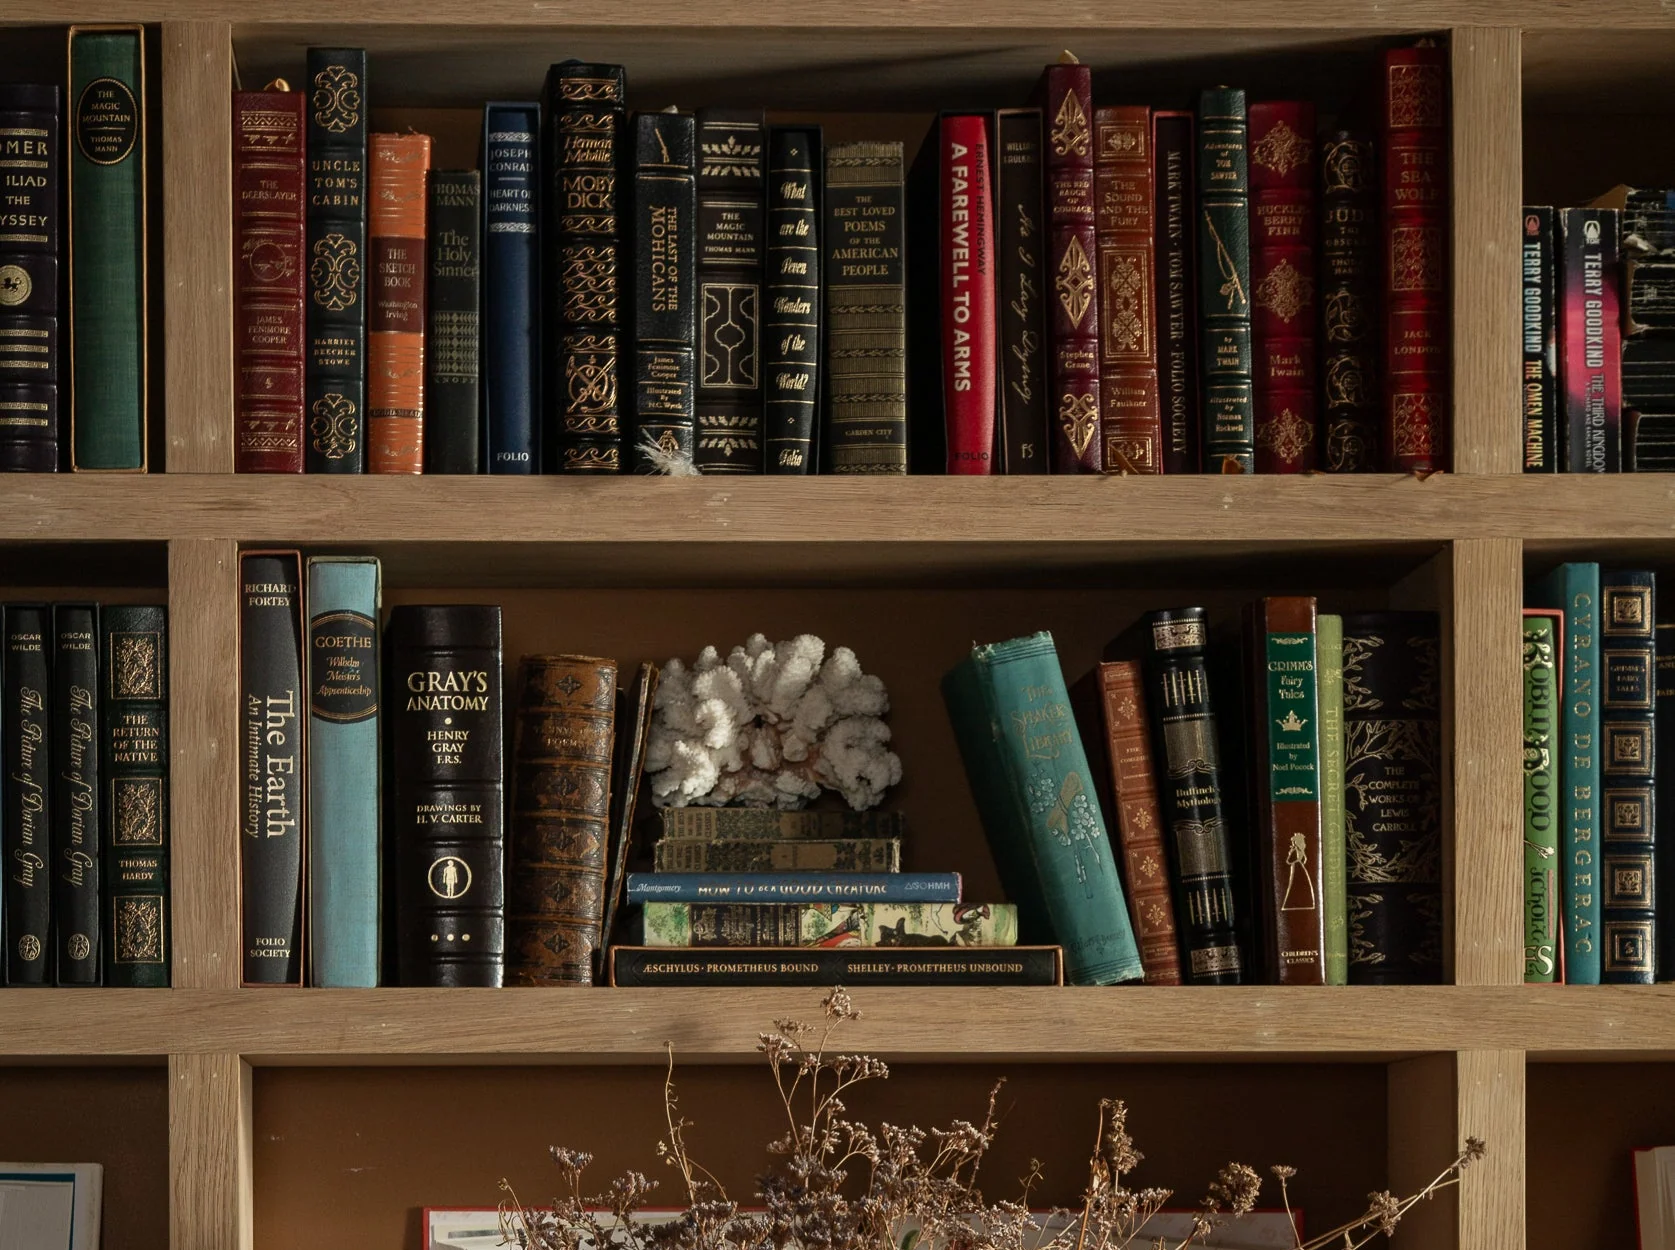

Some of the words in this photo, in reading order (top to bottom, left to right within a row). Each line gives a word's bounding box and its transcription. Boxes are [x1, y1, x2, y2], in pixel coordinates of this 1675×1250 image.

[97, 90, 117, 99] THE
[91, 102, 121, 111] MAGIC
[82, 114, 131, 123] MOUNTAIN
[91, 136, 123, 144] THOMAS
[564, 136, 613, 150] Herman
[491, 149, 532, 161] JOSEPH
[565, 150, 612, 163] Melville
[952, 143, 968, 159] A
[1401, 152, 1434, 166] THE
[312, 160, 361, 172] UNCLE
[490, 162, 533, 173] CONRAD
[6, 175, 47, 188] ILIAD
[315, 177, 358, 189] TOM'S
[563, 175, 616, 191] MOBY
[1401, 170, 1431, 184] SEA
[260, 180, 279, 190] THE
[433, 183, 480, 195] THOMAS
[1112, 180, 1136, 190] THE
[242, 191, 297, 201] DEERSLAYER
[312, 194, 359, 206] CABIN
[1105, 192, 1143, 202] SOUND
[1394, 188, 1439, 201] WOLF
[5, 196, 31, 206] THE
[567, 193, 613, 209] DICK
[490, 203, 534, 213] DARKNESS
[833, 208, 859, 217] BEST
[862, 206, 896, 216] LOVED
[721, 212, 740, 220] THE
[1111, 217, 1138, 226] FURY
[716, 223, 745, 231] MAGIC
[843, 220, 887, 232] POEMS
[952, 165, 971, 289] FAREWELL
[440, 230, 470, 246] The
[706, 233, 755, 242] MOUNTAIN
[975, 191, 987, 277] HEMINGWAY
[387, 248, 407, 260] THE
[437, 248, 472, 265] Holy
[650, 204, 666, 312] MOHICANS
[831, 247, 899, 259] AMERICAN
[380, 262, 416, 275] SKETCH
[1524, 241, 1541, 284] TERRY
[433, 262, 482, 279] Sinner
[841, 264, 889, 276] PEOPLE
[1584, 252, 1602, 295] TERRY
[384, 276, 411, 288] BOOK
[667, 287, 678, 311] THE
[774, 296, 812, 315] Wonders
[954, 291, 971, 323] TO
[1524, 289, 1543, 353] GOODKIND
[249, 325, 292, 335] FENIMORE
[1585, 300, 1604, 368] GOODKIND
[252, 335, 287, 345] COOPER
[314, 338, 355, 347] HARRIET
[313, 349, 357, 357] BEECHER
[1060, 350, 1094, 359] Stephen
[1270, 354, 1301, 364] Mark
[954, 329, 971, 392] ARMS
[1065, 361, 1090, 369] Crane
[1271, 367, 1304, 377] Twain
[1525, 359, 1543, 380] THE
[776, 372, 809, 391] World?
[1591, 374, 1604, 395] THE
[1110, 399, 1147, 408] Faulkner
[1591, 396, 1604, 427] THIRD
[1527, 414, 1544, 469] MACHINE
[497, 451, 529, 462] FOLIO
[779, 449, 803, 467] Folio
[245, 583, 297, 593] RICHARD
[250, 596, 291, 606] FORTEY
[11, 633, 41, 641] OSCAR
[61, 632, 91, 640] OSCAR
[316, 636, 372, 648] GOETHE
[1573, 591, 1592, 719] CYRANO
[326, 656, 361, 668] Wilhelm
[1268, 660, 1314, 671] GRIMM'S
[327, 670, 361, 682] Meister's
[407, 671, 488, 693] GRAY'S
[1280, 676, 1303, 688] Fairy
[317, 684, 372, 698] Apprenticeship
[1278, 689, 1305, 700] Tales
[248, 694, 263, 718] An
[406, 695, 489, 711] ANATOMY
[122, 715, 149, 725] THE
[266, 690, 296, 745] The
[113, 727, 160, 737] RETURN
[427, 731, 470, 741] HENRY
[132, 740, 158, 750] THE
[248, 720, 263, 781] Intimate
[431, 743, 465, 753] GRAY
[1276, 741, 1310, 750] Illustrated
[114, 752, 158, 762] NATIVE
[1574, 735, 1592, 770] DE
[436, 755, 462, 764] F.R.S.
[1384, 766, 1405, 776] THE
[1368, 780, 1420, 790] COMPLETE
[266, 754, 296, 838] Earth
[1368, 795, 1405, 804] WORKS
[245, 784, 263, 839] History
[416, 804, 467, 813] DRAWINGS
[470, 804, 482, 813] BY
[1381, 809, 1409, 818] LEWIS
[441, 815, 483, 824] CARTER
[119, 860, 157, 868] THOMAS
[1574, 785, 1592, 954] BERGERAC
[122, 872, 154, 880] HARDY
[255, 937, 285, 946] FOLIO
[250, 949, 291, 958] SOCIETY
[706, 962, 778, 973] PROMETHEUS
[780, 962, 819, 973] BOUND
[847, 962, 891, 973] SHELLEY
[896, 962, 967, 973] PROMETHEUS
[969, 962, 1023, 973] UNBOUND
